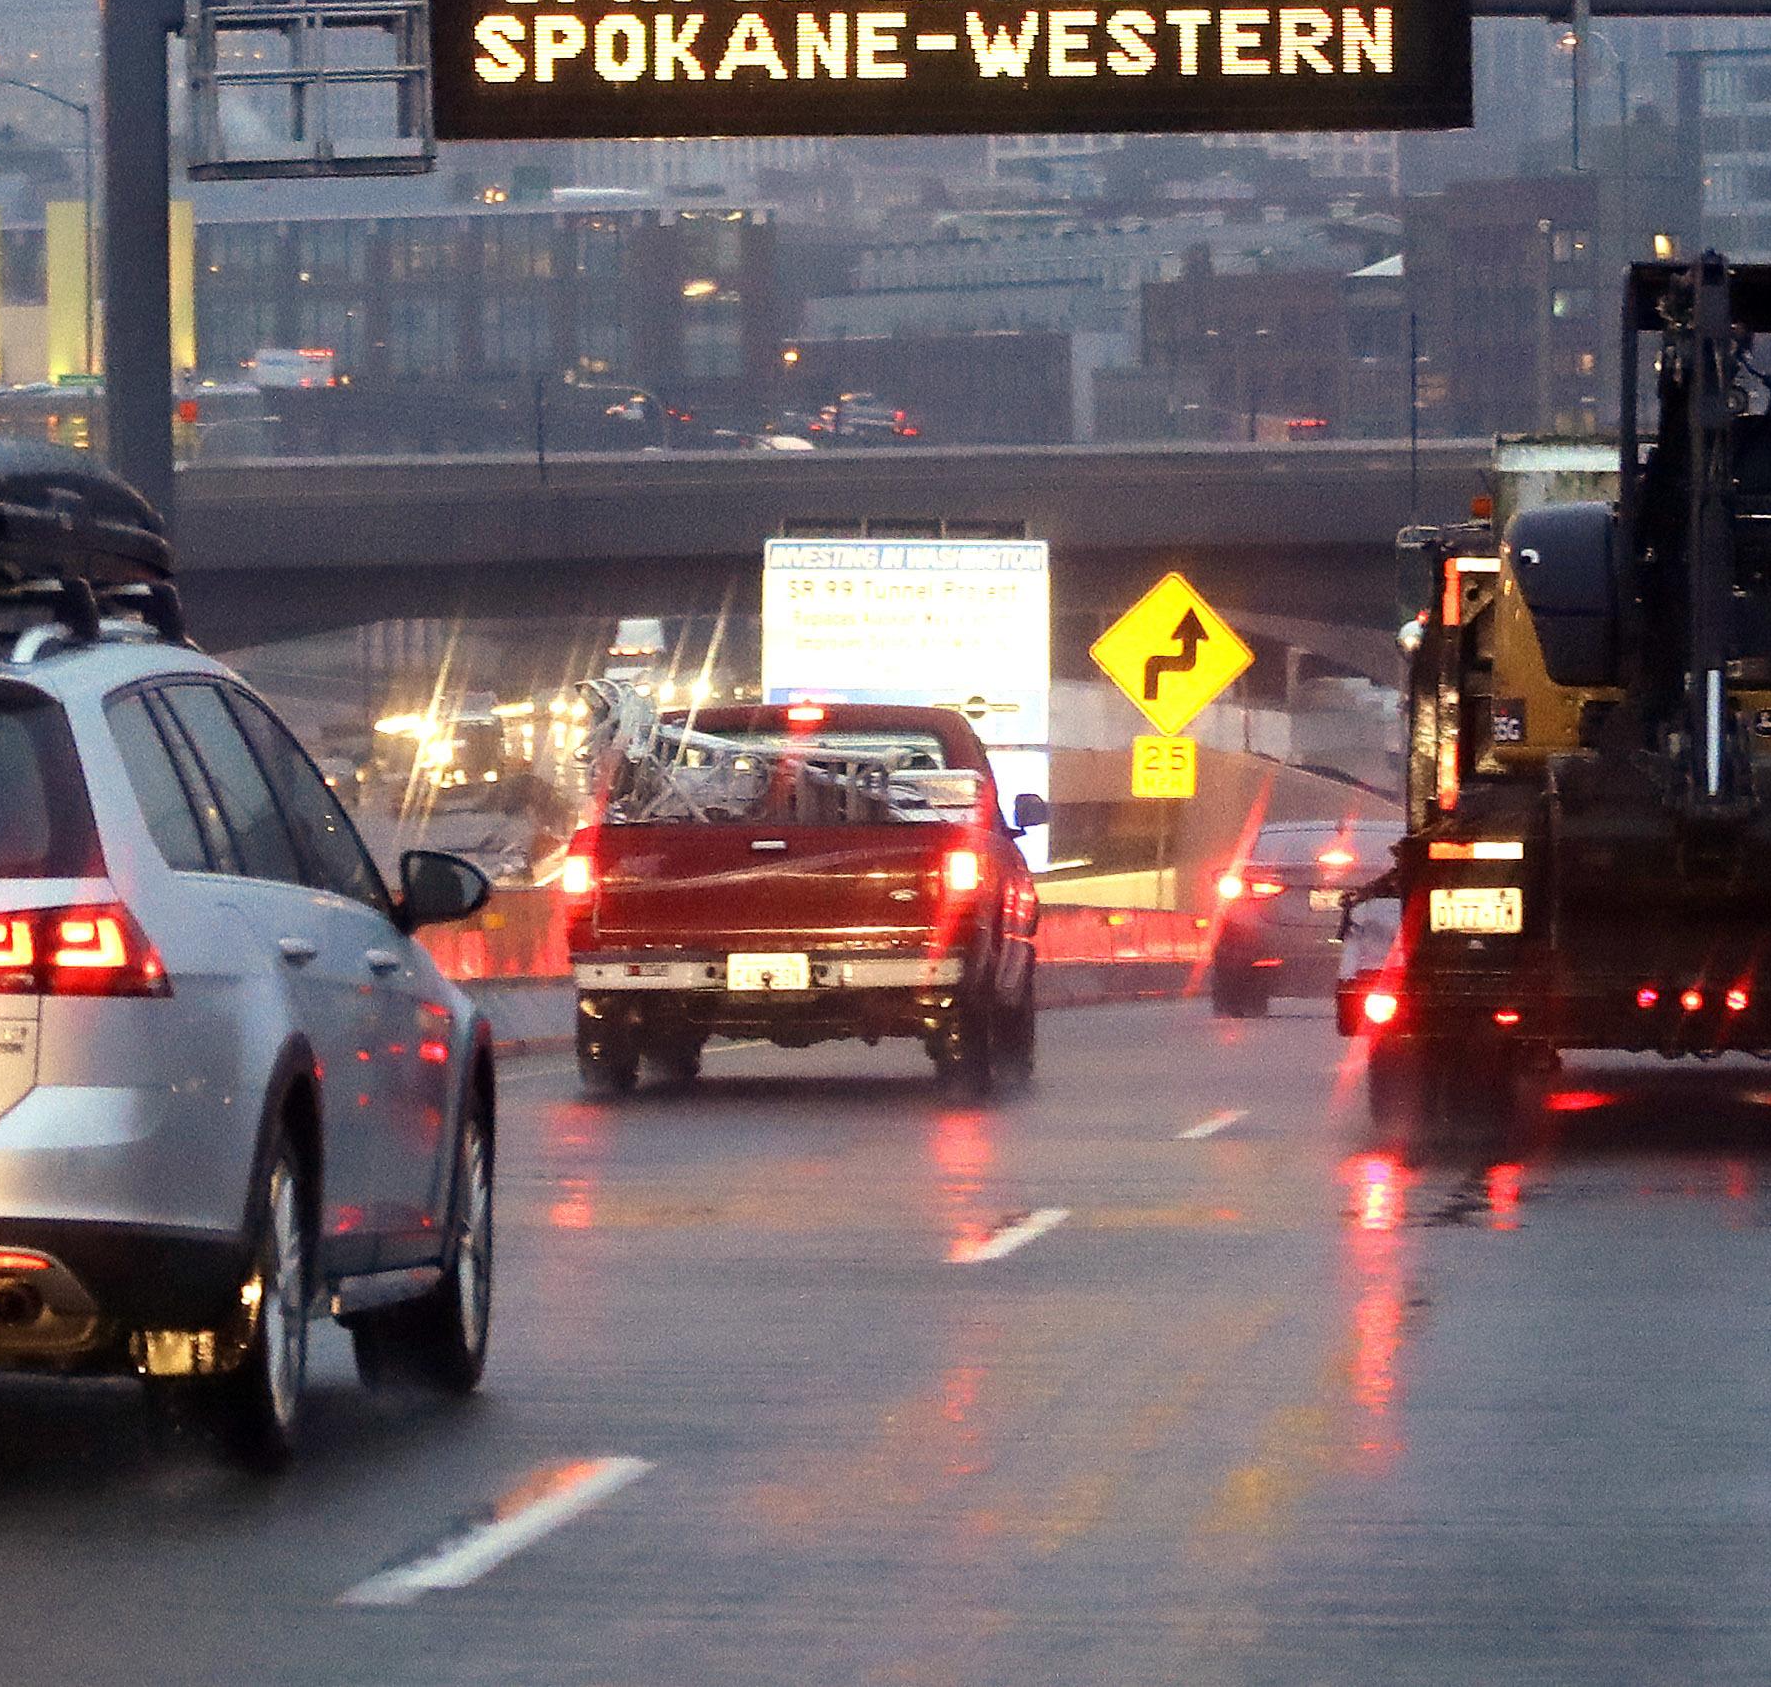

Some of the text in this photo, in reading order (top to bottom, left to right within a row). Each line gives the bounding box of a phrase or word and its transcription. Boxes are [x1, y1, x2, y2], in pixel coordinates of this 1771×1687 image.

[473, 6, 1394, 84] SPOKANE-WESTERN
[771, 546, 1043, 570] INVESTING IN WASHINGTON
[787, 579, 815, 601] SR
[825, 579, 853, 600] 99
[862, 579, 933, 601] Tunnel
[1142, 745, 1189, 771] 25
